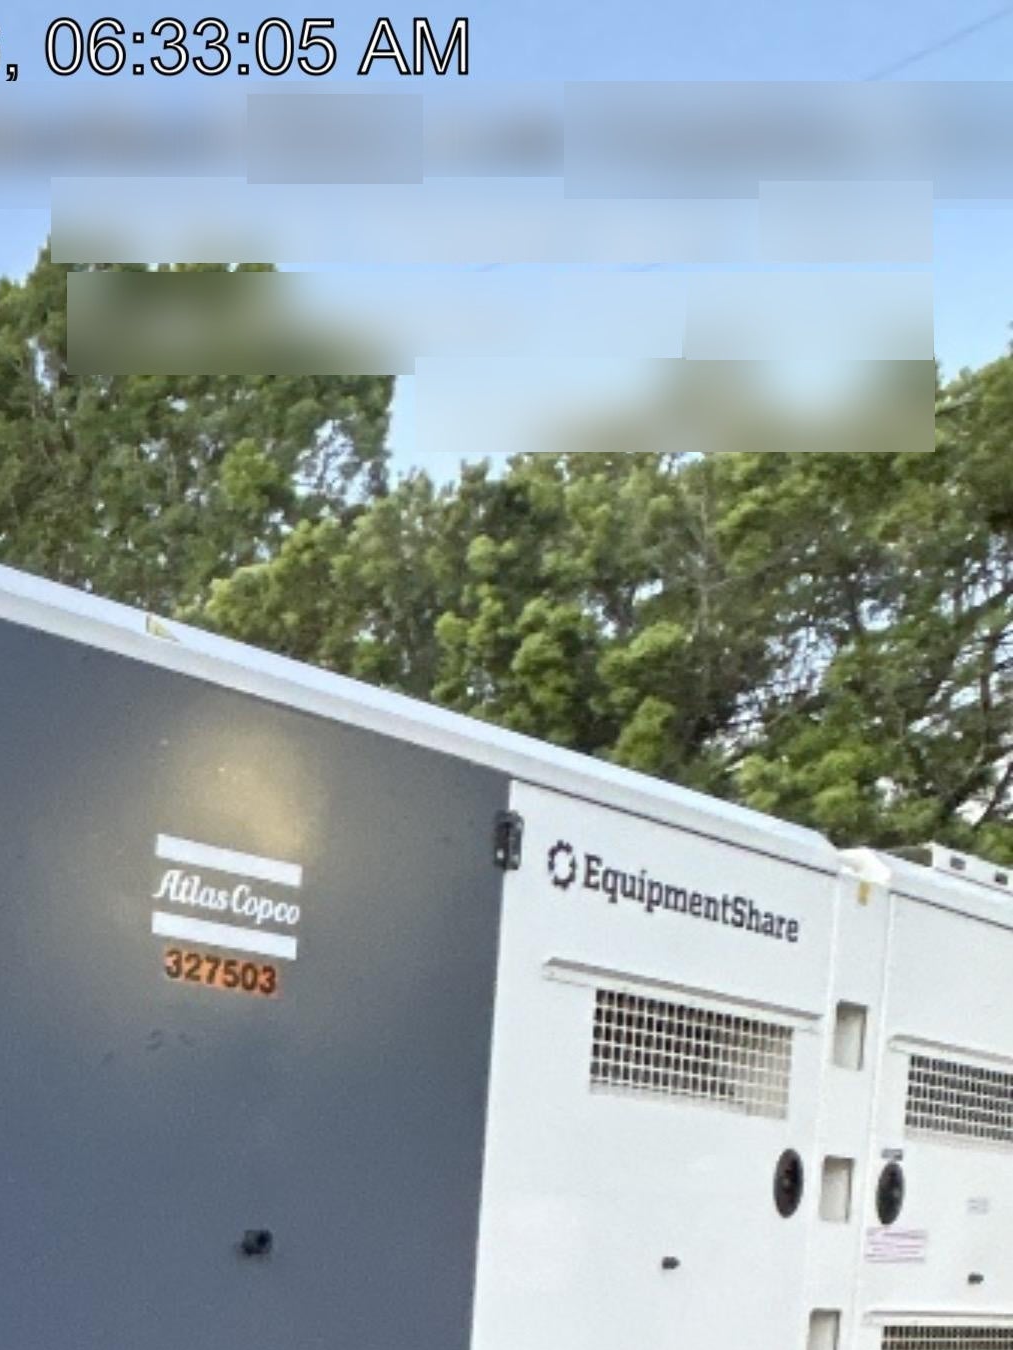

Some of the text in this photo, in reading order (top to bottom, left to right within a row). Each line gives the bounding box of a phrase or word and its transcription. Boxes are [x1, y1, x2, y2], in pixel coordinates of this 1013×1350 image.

[151, 868, 301, 925] Atlas Copco
[582, 852, 800, 943] EquipmentShare
[164, 948, 277, 994] 327503
